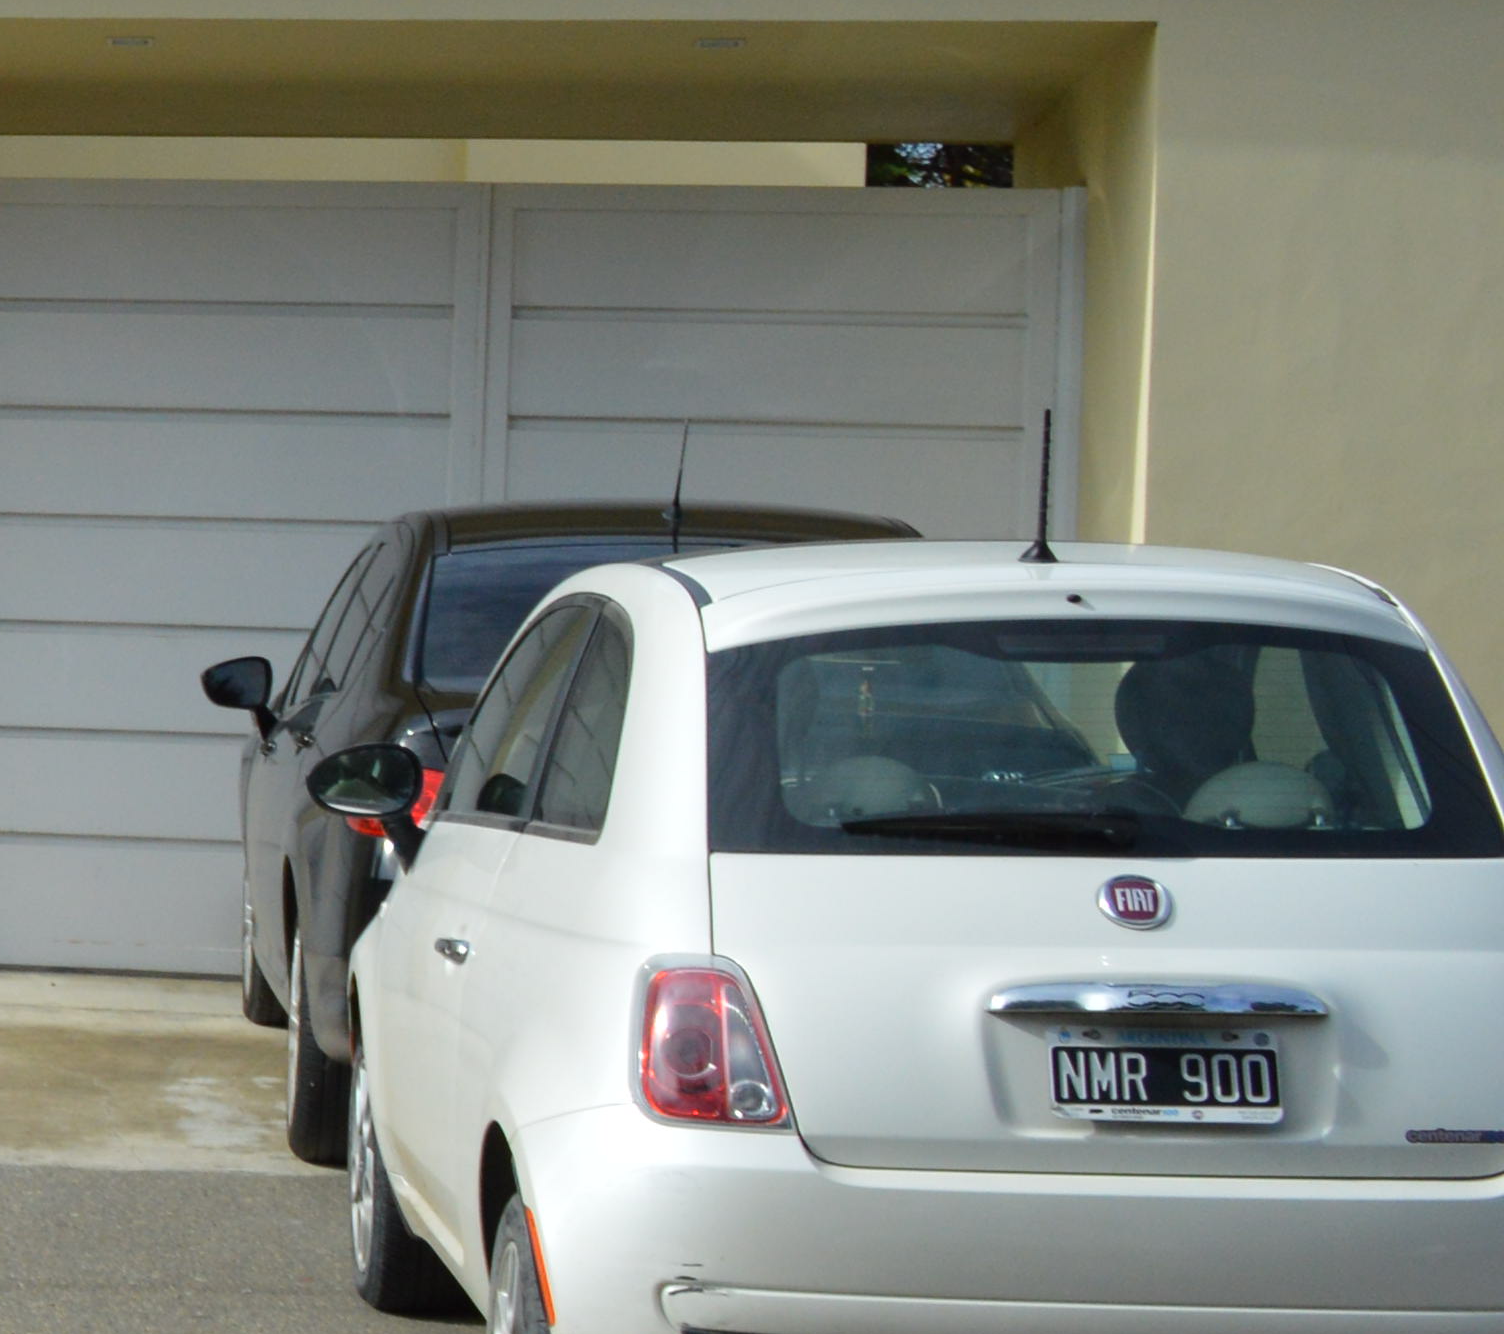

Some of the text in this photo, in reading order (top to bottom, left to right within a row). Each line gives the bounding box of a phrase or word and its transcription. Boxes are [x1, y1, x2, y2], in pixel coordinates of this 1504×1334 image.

[1114, 887, 1156, 913] FIAT
[1057, 1050, 1272, 1104] NMR 900
